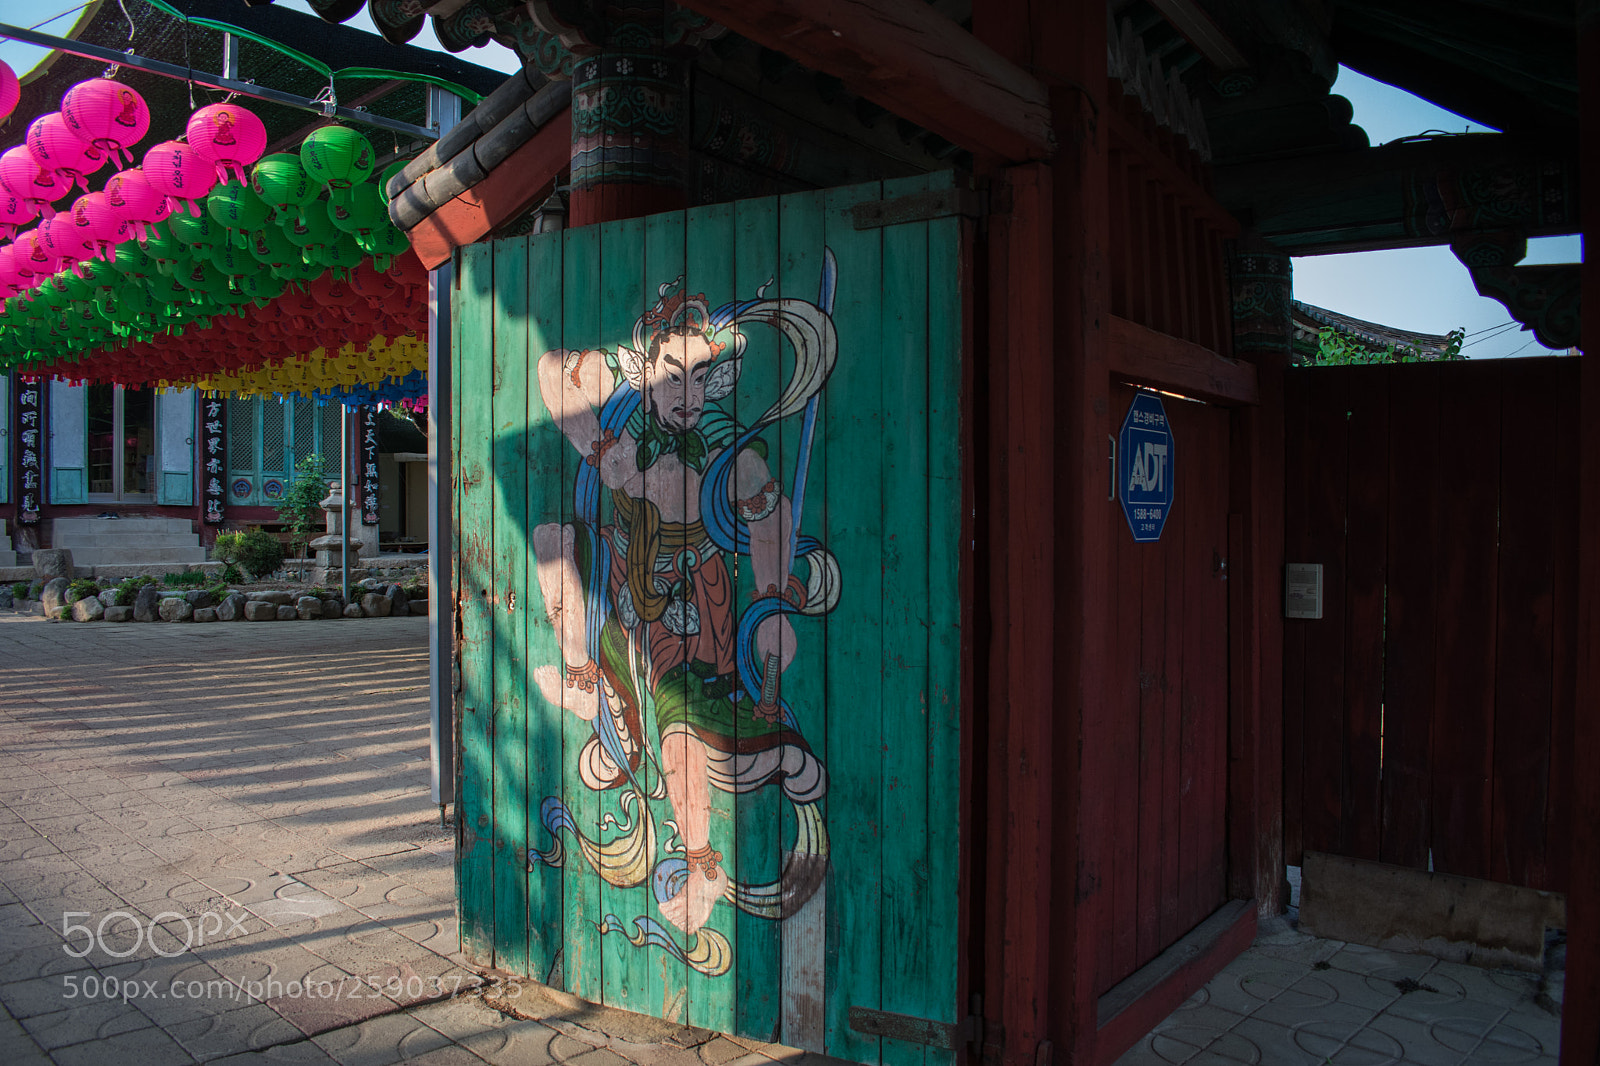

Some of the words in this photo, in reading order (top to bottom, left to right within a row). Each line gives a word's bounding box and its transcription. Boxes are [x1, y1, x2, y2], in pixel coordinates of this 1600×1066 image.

[205, 389, 224, 513] 方世界亦無比
[1128, 442, 1167, 492] ADT
[1134, 508, 1162, 520] 1588-6400
